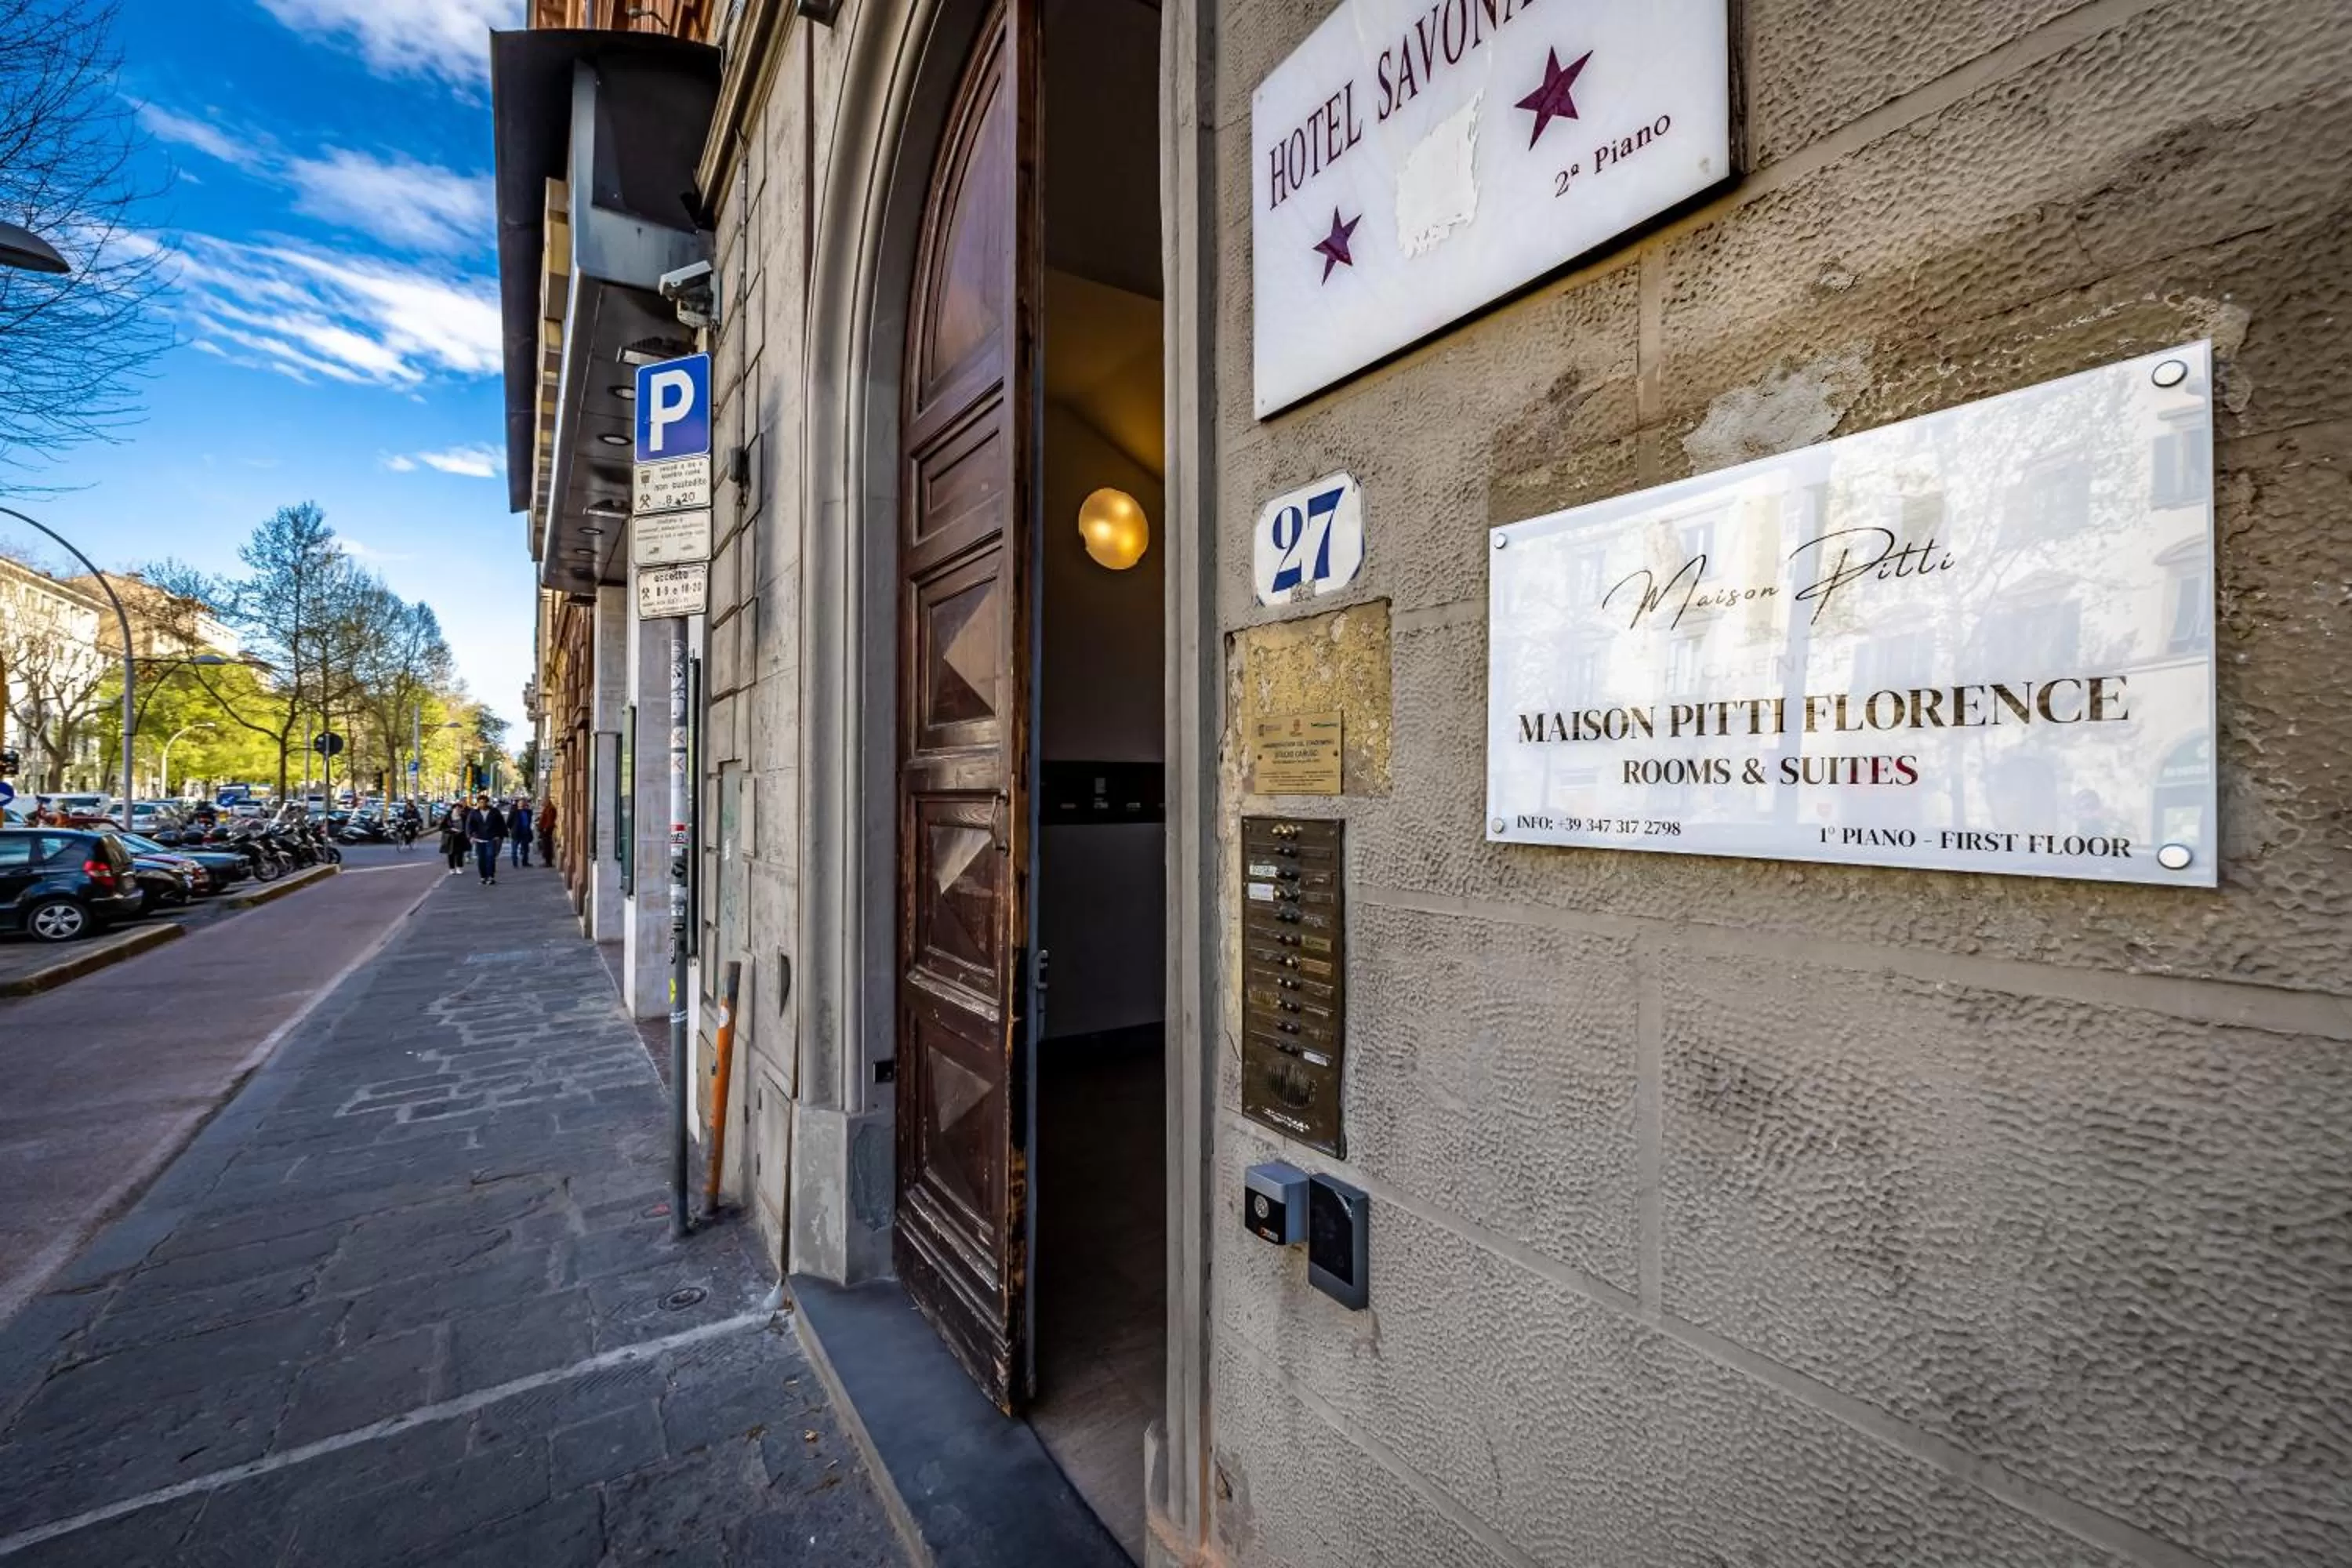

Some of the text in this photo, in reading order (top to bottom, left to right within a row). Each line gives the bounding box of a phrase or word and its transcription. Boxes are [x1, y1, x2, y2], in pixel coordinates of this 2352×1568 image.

[1269, 0, 1534, 211] HOTEL SAVON
[1594, 114, 1671, 176] Piano
[650, 368, 695, 452] P
[682, 492, 695, 502] 20
[1271, 487, 1346, 593] 27
[1602, 527, 1956, 630] Maison Pitti
[1519, 676, 2129, 743] MAISON PITTI FLORENCE
[1623, 755, 1918, 785] ROOMS & SUITES
[1517, 815, 1553, 830] INFO:
[1586, 818, 1611, 833] 347
[1616, 820, 1639, 833] 317
[1644, 821, 1681, 835] 2798
[1842, 827, 1915, 848] PIANO
[1940, 831, 2019, 852] FIRST
[2028, 835, 2132, 858] FLOOR
